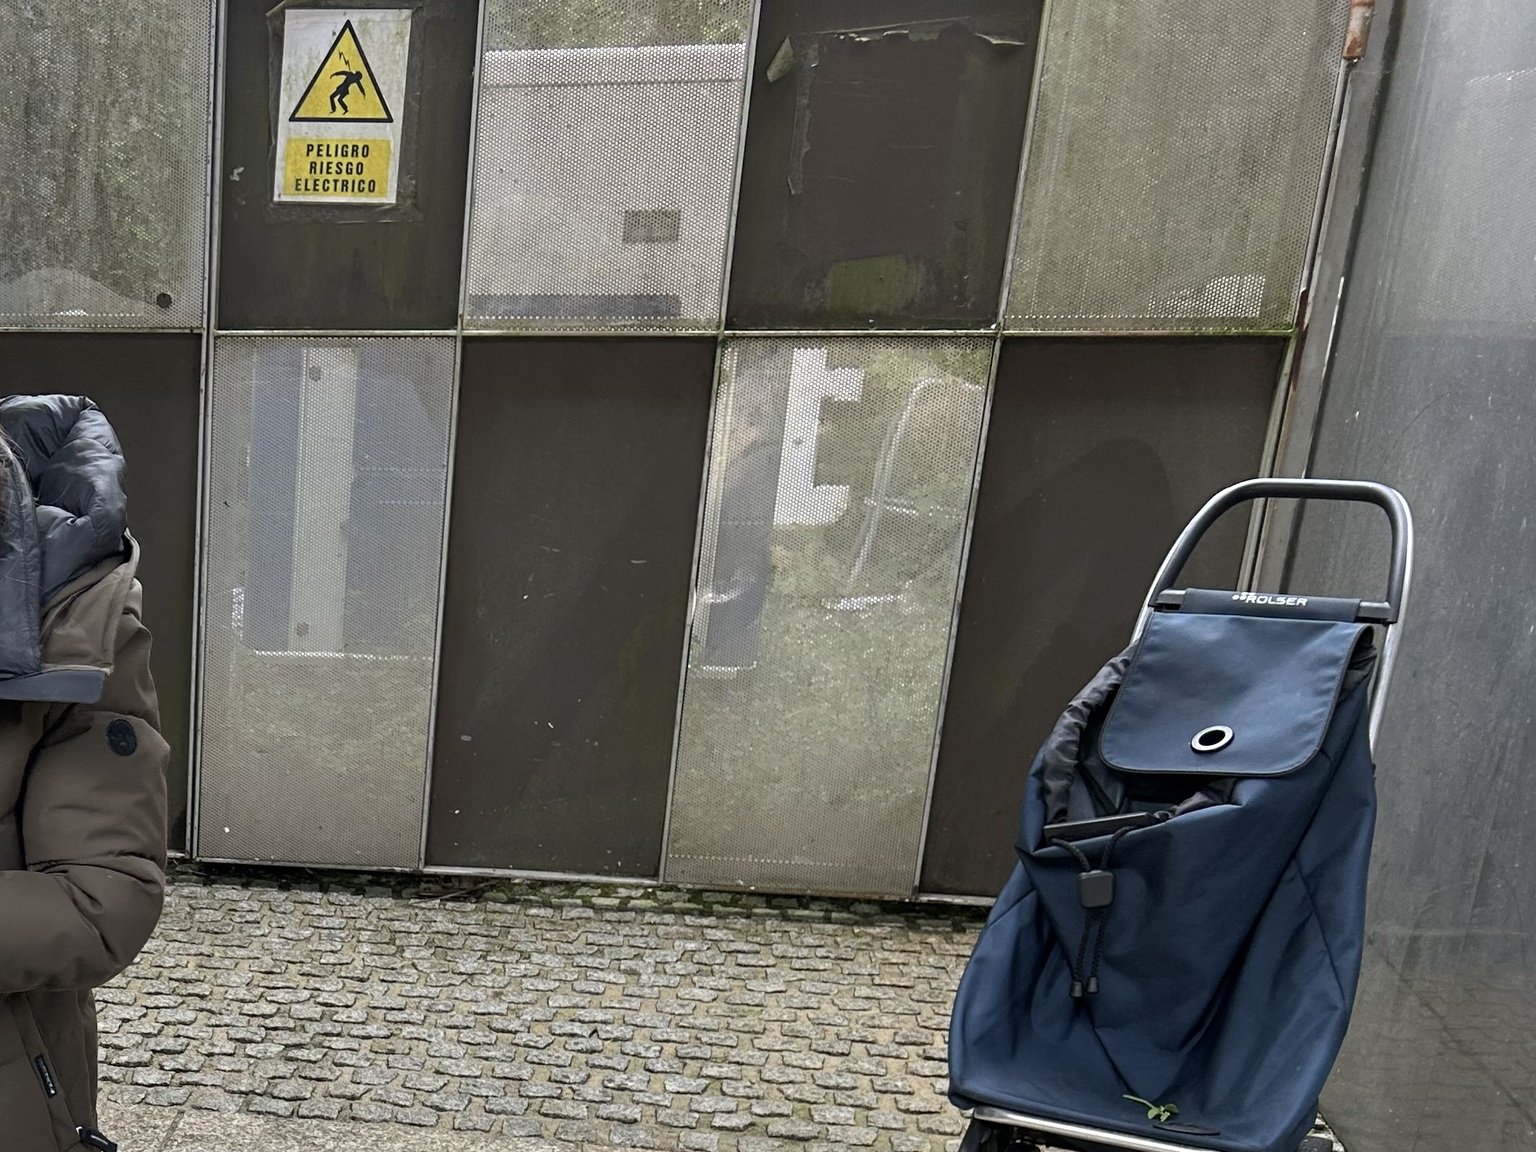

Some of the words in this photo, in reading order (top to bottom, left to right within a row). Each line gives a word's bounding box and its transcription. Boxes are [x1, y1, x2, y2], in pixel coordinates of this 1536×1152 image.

[306, 144, 370, 158] PELIGRO
[309, 161, 364, 176] RIESGO
[295, 178, 376, 193] ELECTRICO
[1245, 595, 1308, 606] ROLSER
